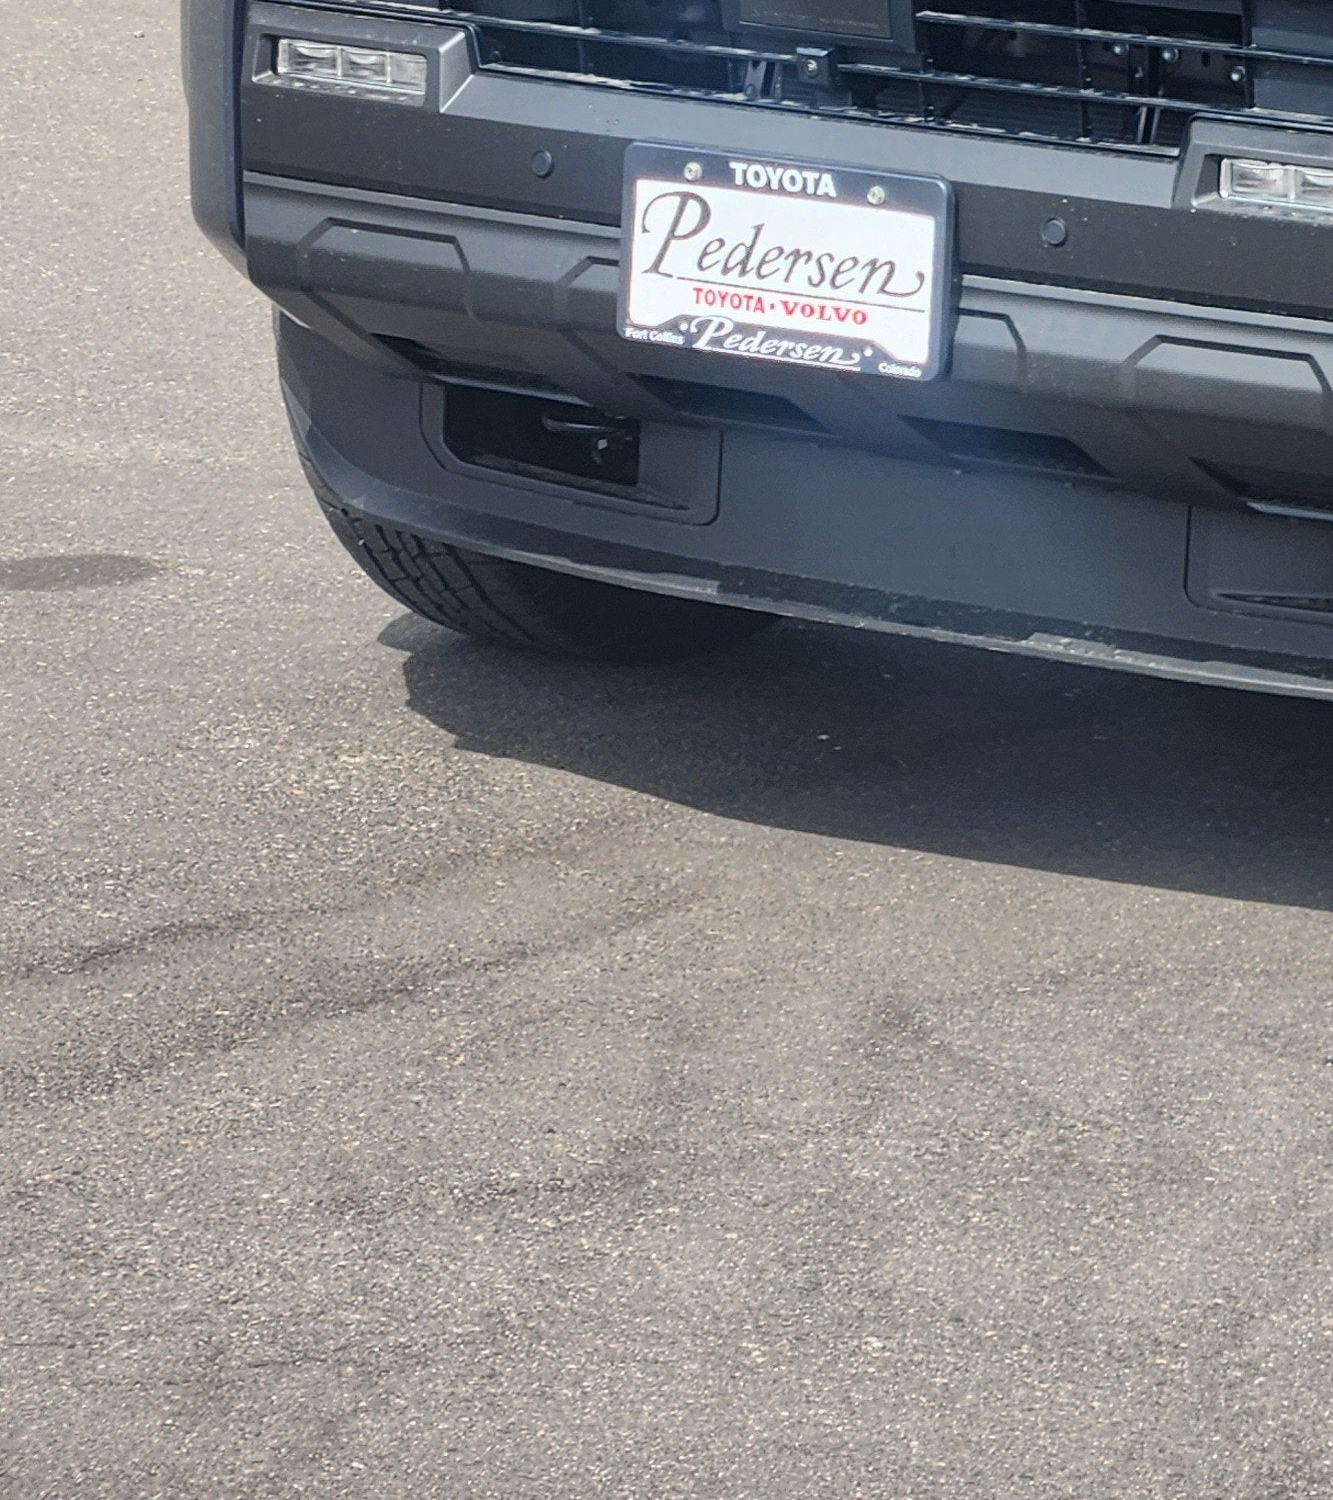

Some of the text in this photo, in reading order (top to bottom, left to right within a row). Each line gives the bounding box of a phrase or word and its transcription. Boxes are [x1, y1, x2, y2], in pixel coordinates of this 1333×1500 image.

[729, 162, 838, 198] TOYOTA
[641, 191, 926, 298] Pedersen
[693, 287, 869, 326] TOYOTA VOLVO
[690, 315, 861, 366] Pedersen
